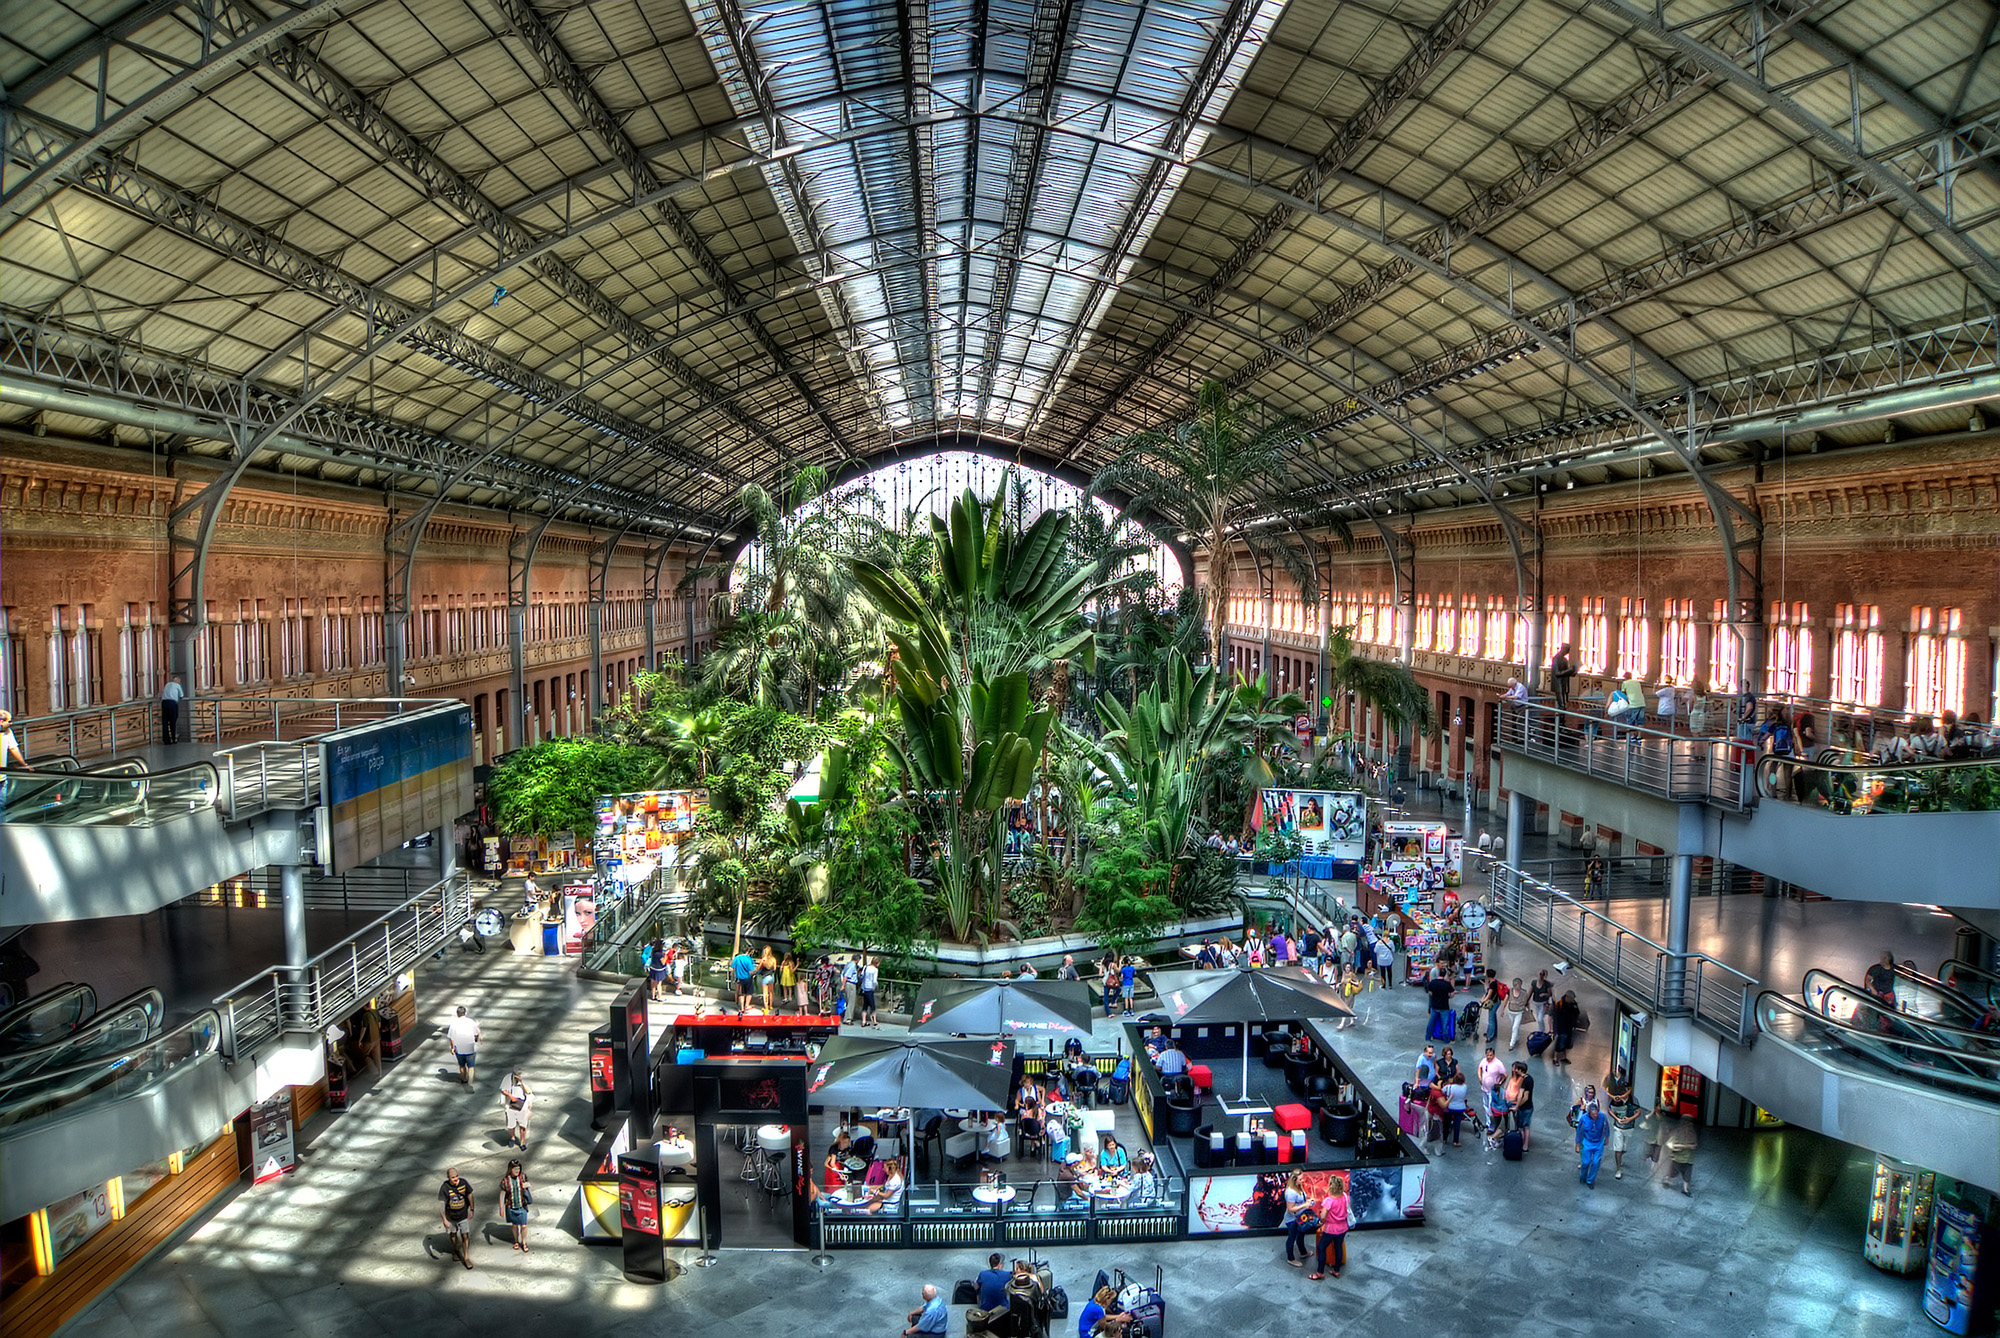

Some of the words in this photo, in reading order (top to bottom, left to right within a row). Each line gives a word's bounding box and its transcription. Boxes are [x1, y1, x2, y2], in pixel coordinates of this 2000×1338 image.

[369, 756, 384, 773] paga
[1016, 1022, 1048, 1030] WINE
[1048, 1021, 1075, 1033] Plaza
[92, 1193, 107, 1219] 13
